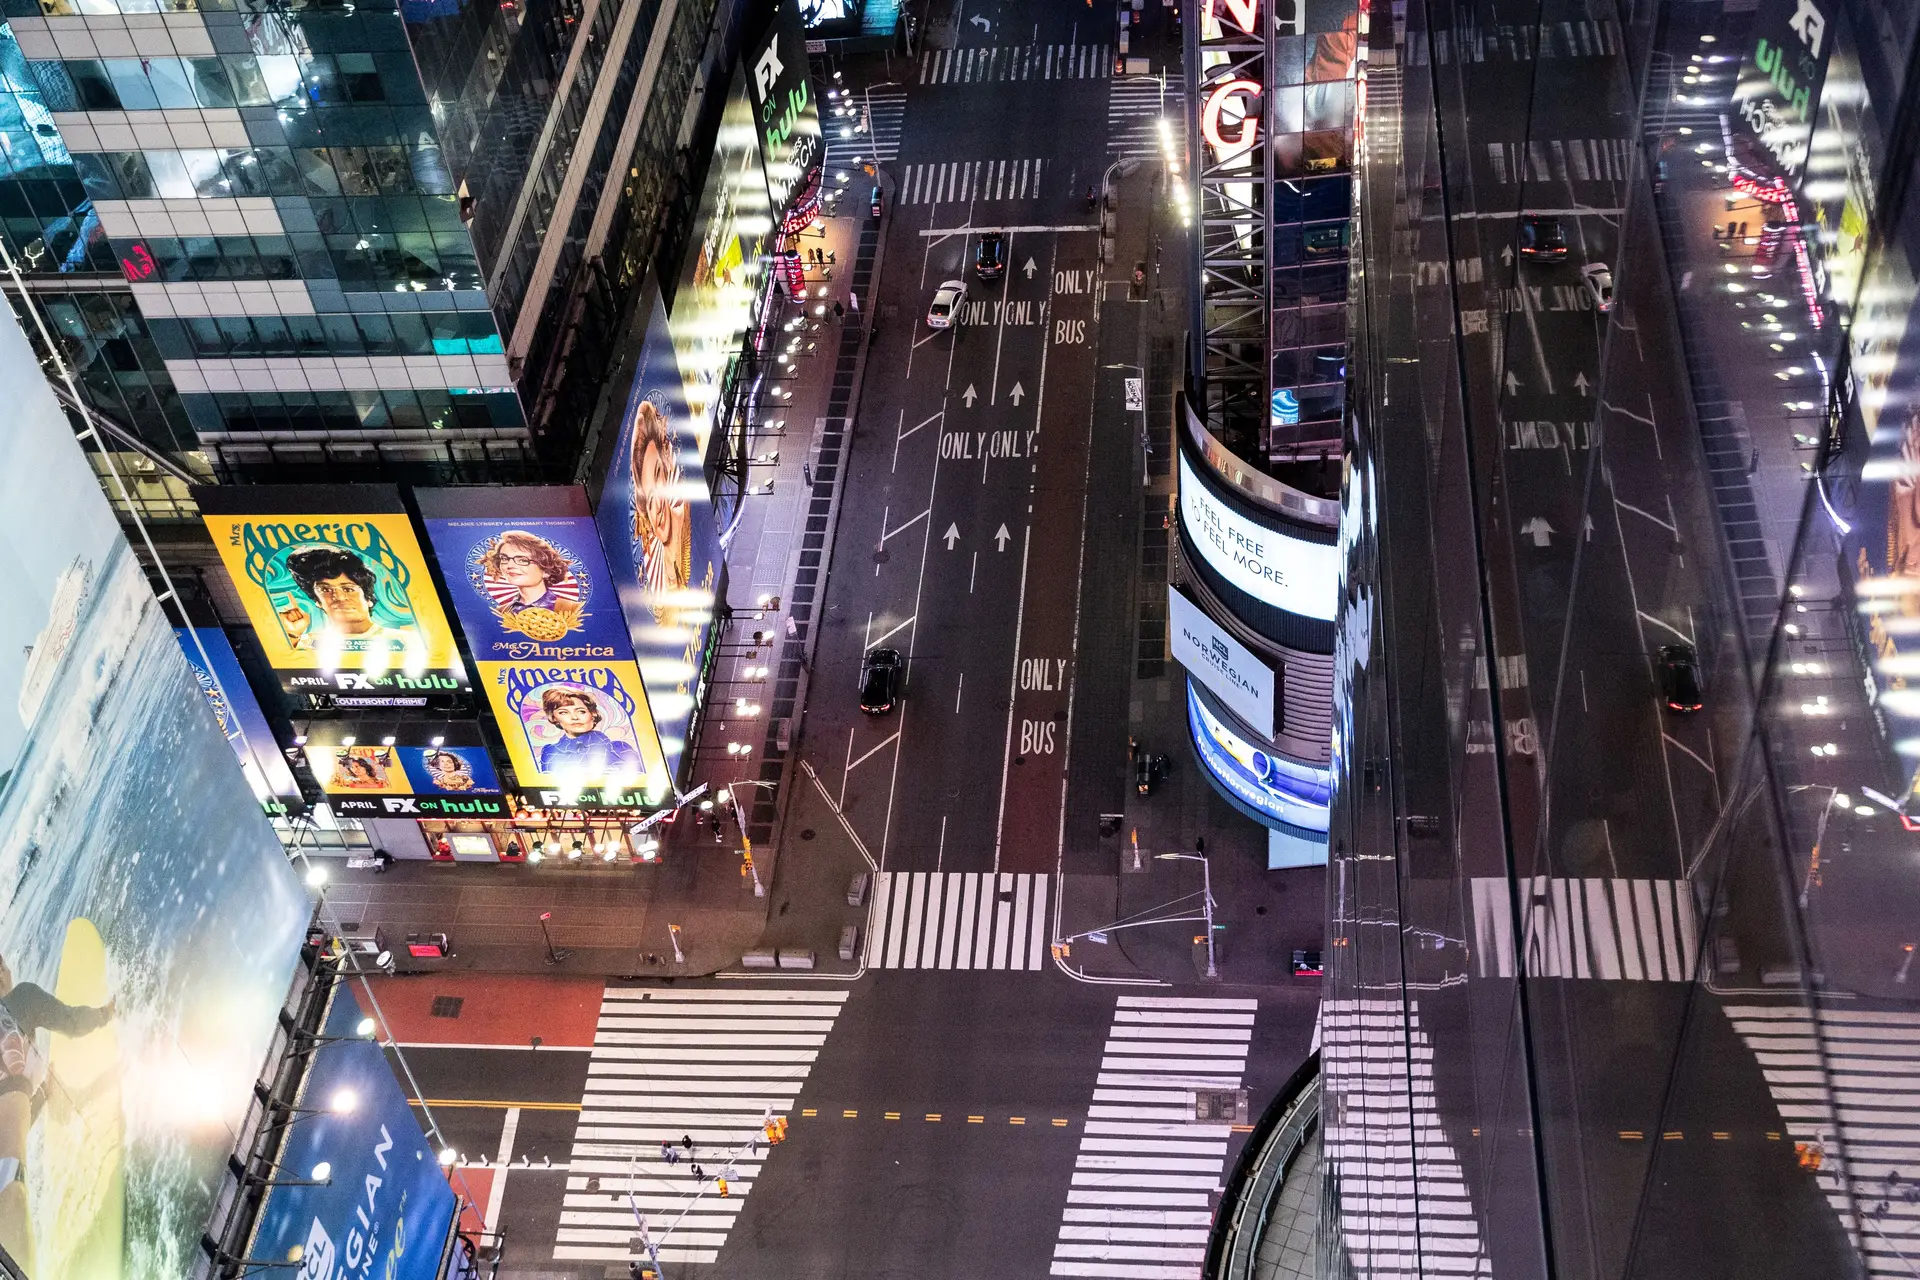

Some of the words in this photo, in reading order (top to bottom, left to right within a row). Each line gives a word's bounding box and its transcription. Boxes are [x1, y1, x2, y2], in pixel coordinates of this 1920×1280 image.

[754, 32, 784, 104] FX
[762, 93, 777, 123] ON
[766, 79, 808, 162] hulu
[1055, 270, 1094, 294] ONLY
[960, 301, 1001, 325] ONLY
[1005, 301, 1046, 325] ONLY
[1055, 320, 1085, 344] BUS
[942, 432, 986, 459] ONLY
[991, 431, 1035, 457] ONLY
[1191, 495, 1201, 523] TO
[1203, 521, 1228, 555] FEEL
[1234, 551, 1288, 587] MORE.
[1200, 497, 1223, 532] FEEL
[1228, 527, 1263, 558] FREE
[509, 642, 615, 660] America
[1183, 628, 1258, 698] NORWEGIAN
[291, 677, 328, 686] APRIL
[334, 674, 375, 690] FX
[374, 678, 393, 686] ON
[395, 674, 458, 690] hulu
[1021, 659, 1066, 690] ONLY
[1020, 719, 1055, 754] BUS
[341, 801, 377, 809] APRIL
[382, 798, 420, 813] FX
[441, 799, 500, 813] hulu
[539, 790, 579, 806] FX
[600, 790, 661, 806] hulu
